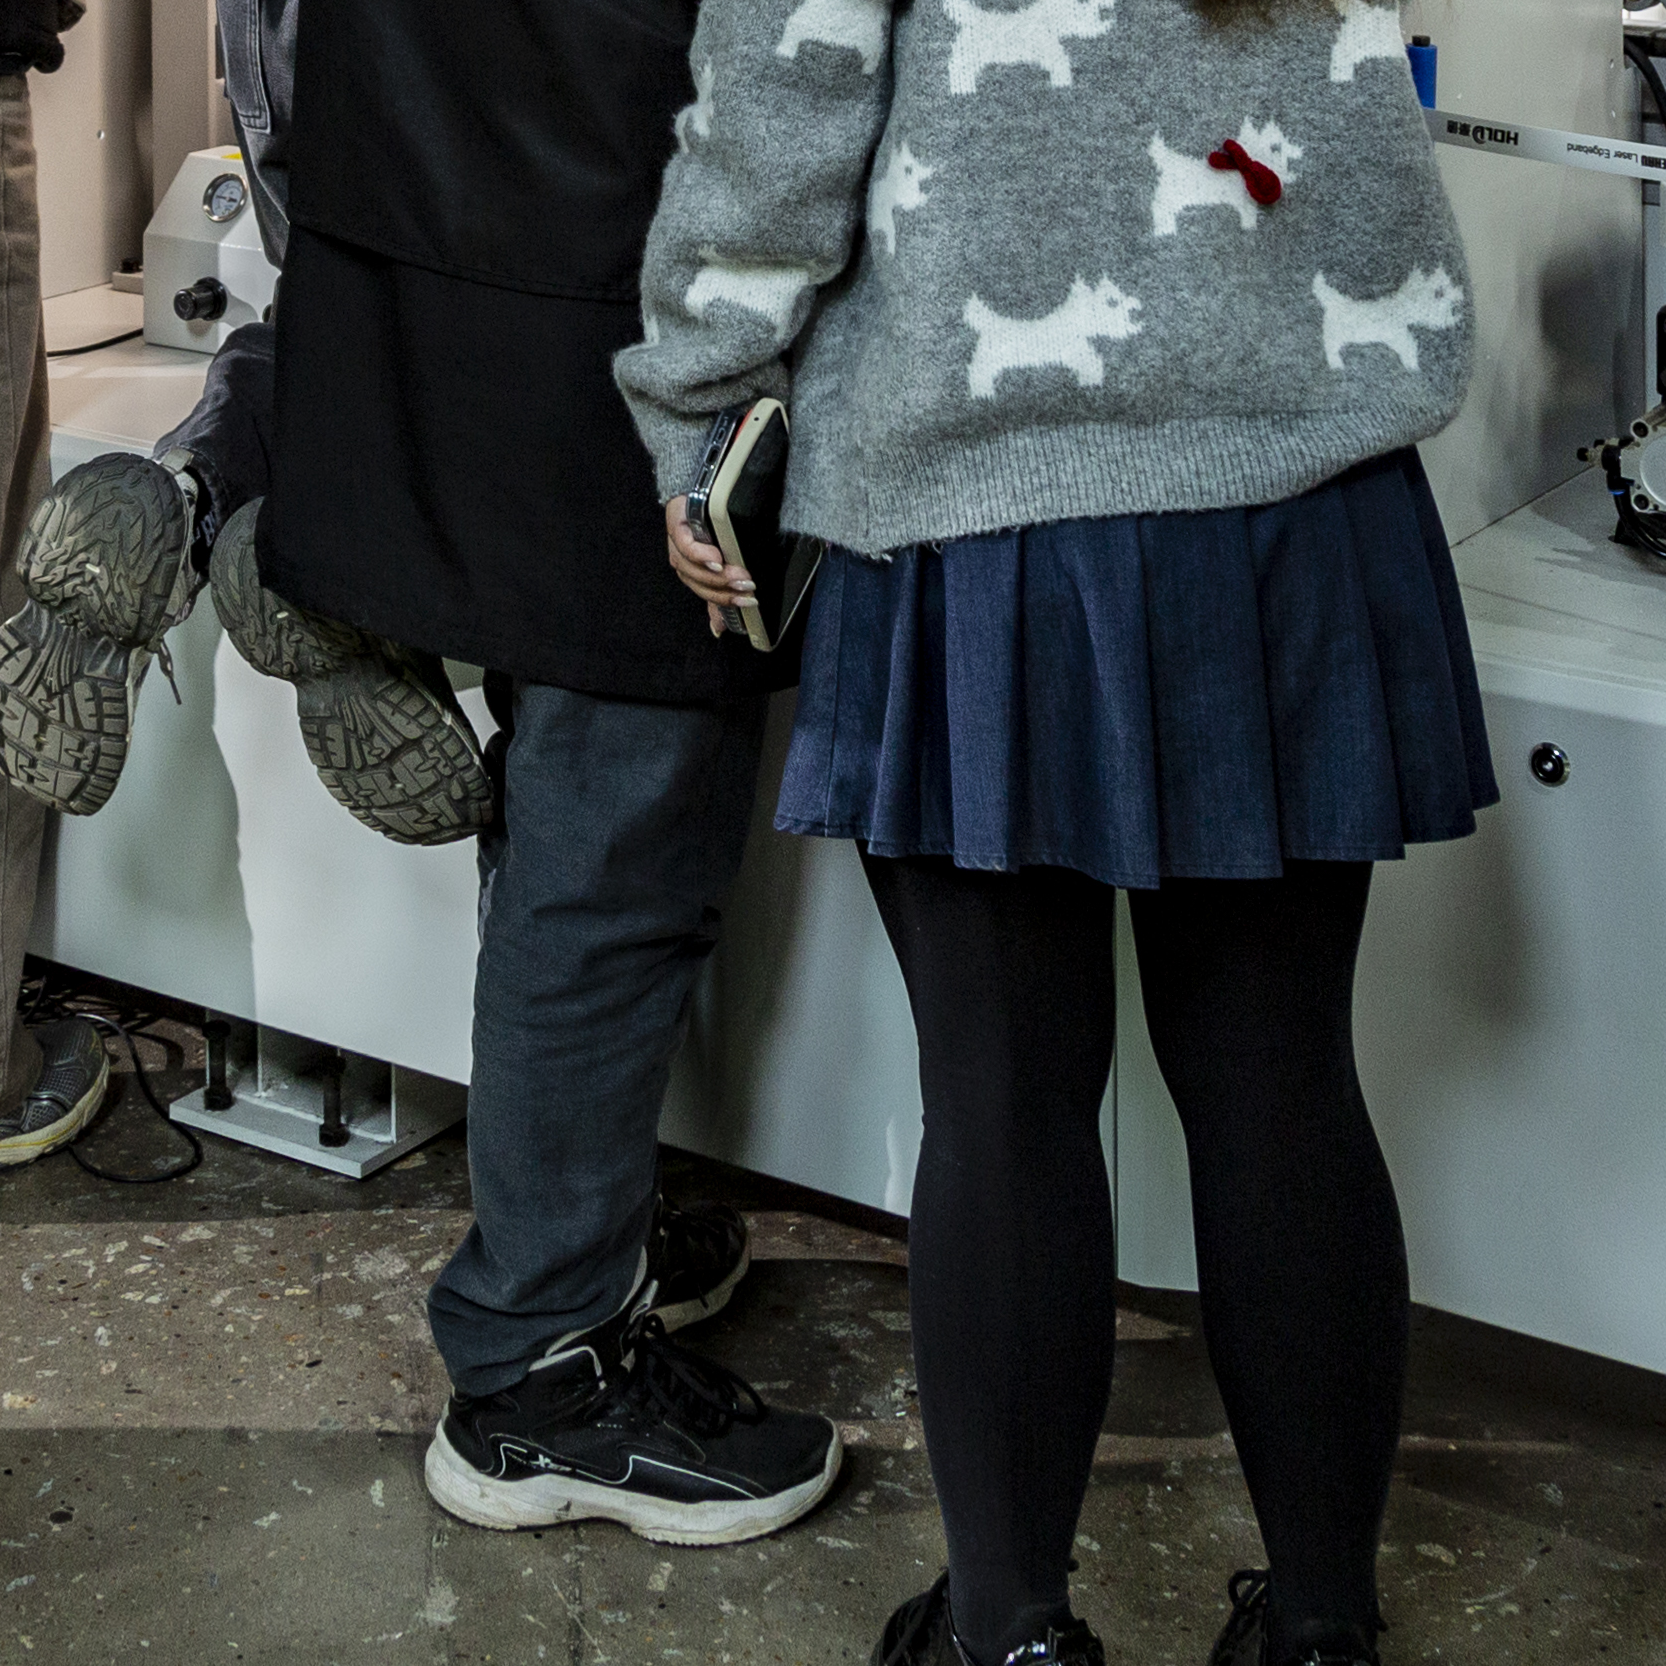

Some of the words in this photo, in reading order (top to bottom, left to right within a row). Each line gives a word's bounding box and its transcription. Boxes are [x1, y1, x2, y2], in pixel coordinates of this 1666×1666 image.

[1472, 124, 1519, 146] HOLD
[1565, 142, 1611, 160] Edgeband
[1612, 150, 1639, 164] Laser
